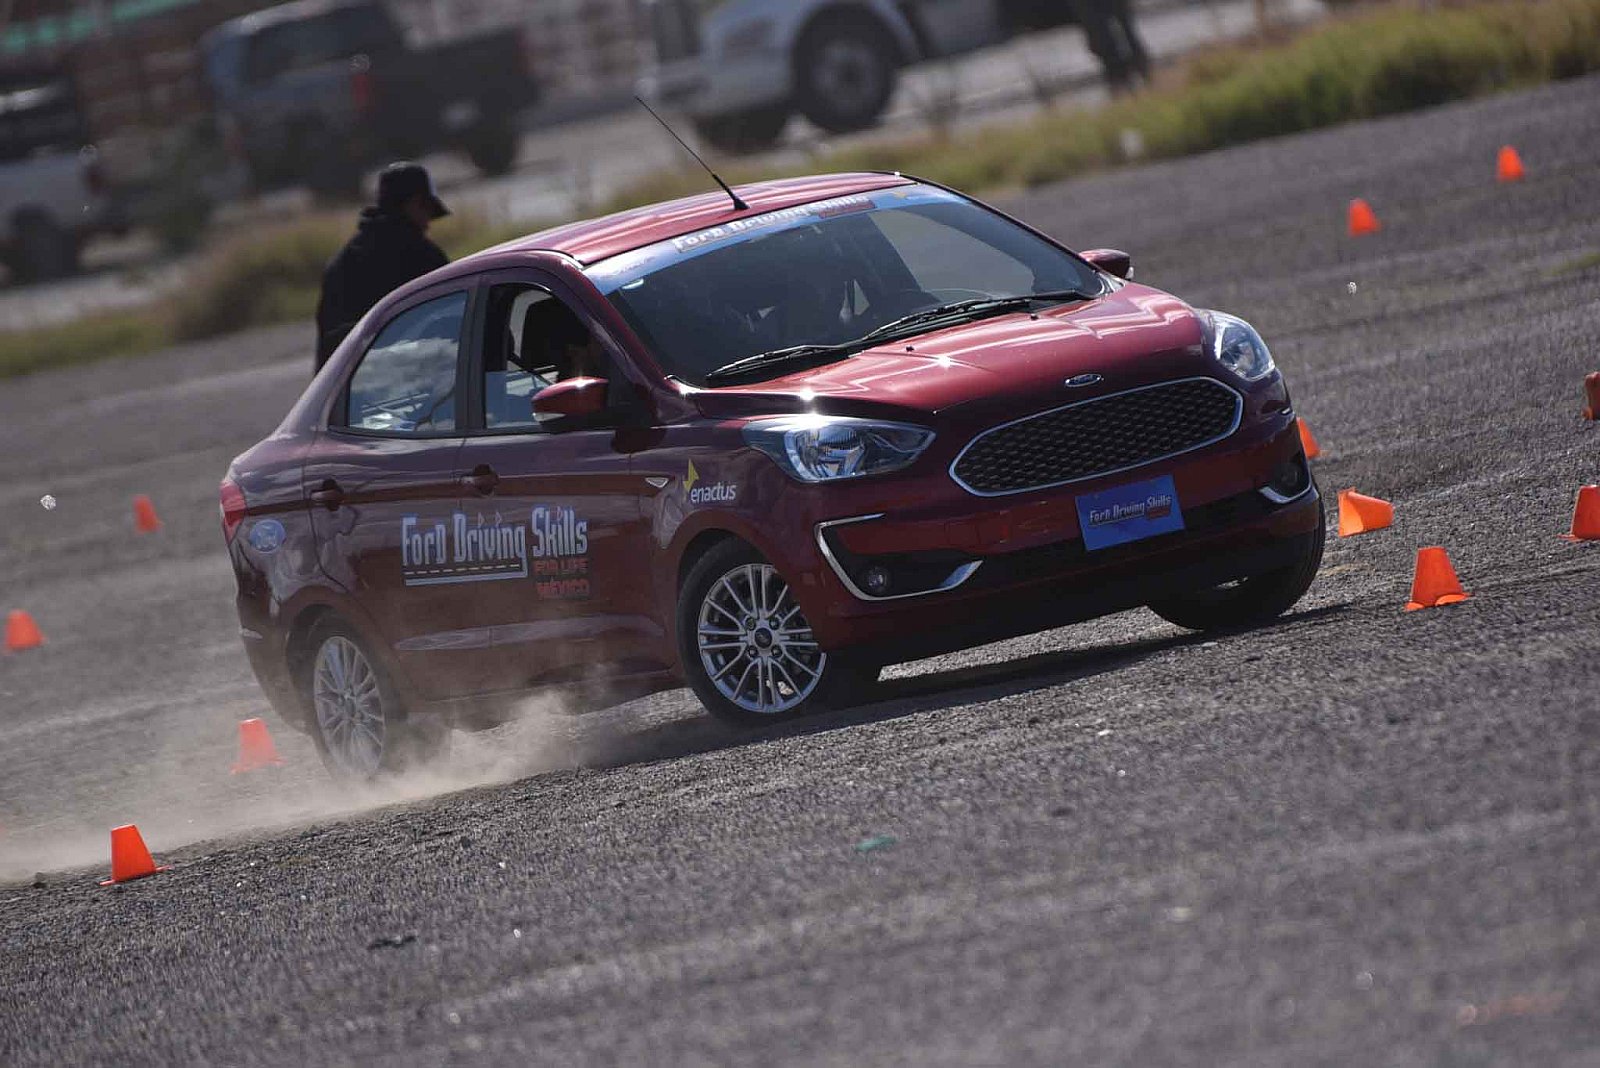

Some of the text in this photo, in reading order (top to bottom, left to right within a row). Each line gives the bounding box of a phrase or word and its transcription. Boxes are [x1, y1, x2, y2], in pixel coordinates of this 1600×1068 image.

[690, 482, 737, 503] enactus
[453, 511, 528, 567] Driving
[531, 506, 588, 558] Skills
